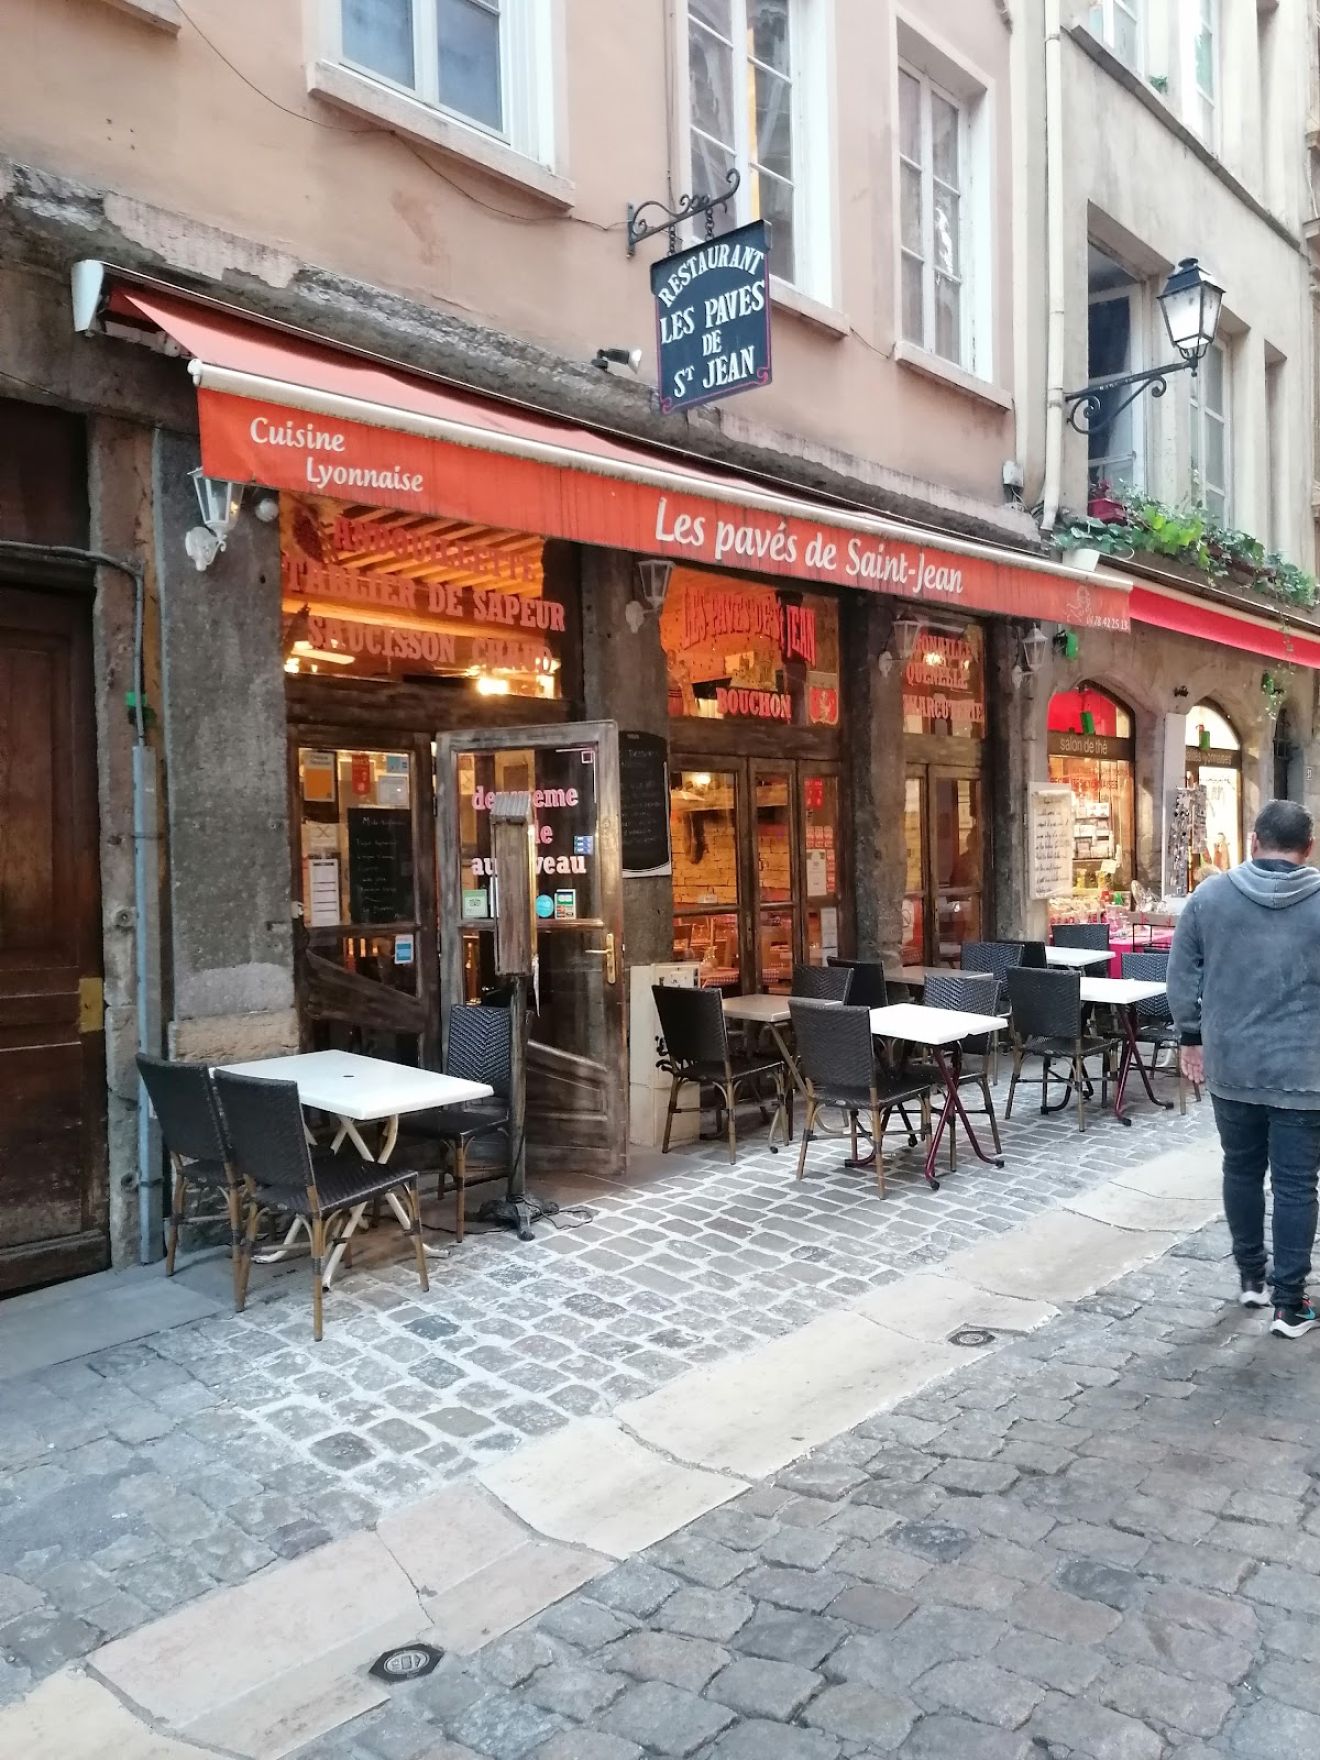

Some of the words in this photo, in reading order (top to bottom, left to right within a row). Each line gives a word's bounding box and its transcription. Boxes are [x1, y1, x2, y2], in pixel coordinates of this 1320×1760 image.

[657, 243, 765, 309] RESTAURANT
[659, 305, 696, 345] LES
[703, 279, 766, 329] PAVES
[702, 329, 723, 357] DE
[702, 344, 756, 390] JEAN
[250, 416, 346, 452] Cuisine
[306, 455, 425, 492] Lyonnaise
[654, 496, 707, 547] Les
[714, 522, 799, 560] pavés
[804, 531, 838, 571] de
[844, 538, 964, 595] Saint-Jean
[281, 553, 417, 611] TABLIER
[427, 582, 464, 617] DE
[472, 585, 566, 632] SAPEUR
[308, 616, 457, 665] SAUCISSON
[785, 604, 817, 670] JEAN
[716, 687, 792, 720] BOUCHON
[1059, 734, 1082, 753] salon
[1083, 738, 1094, 754] de
